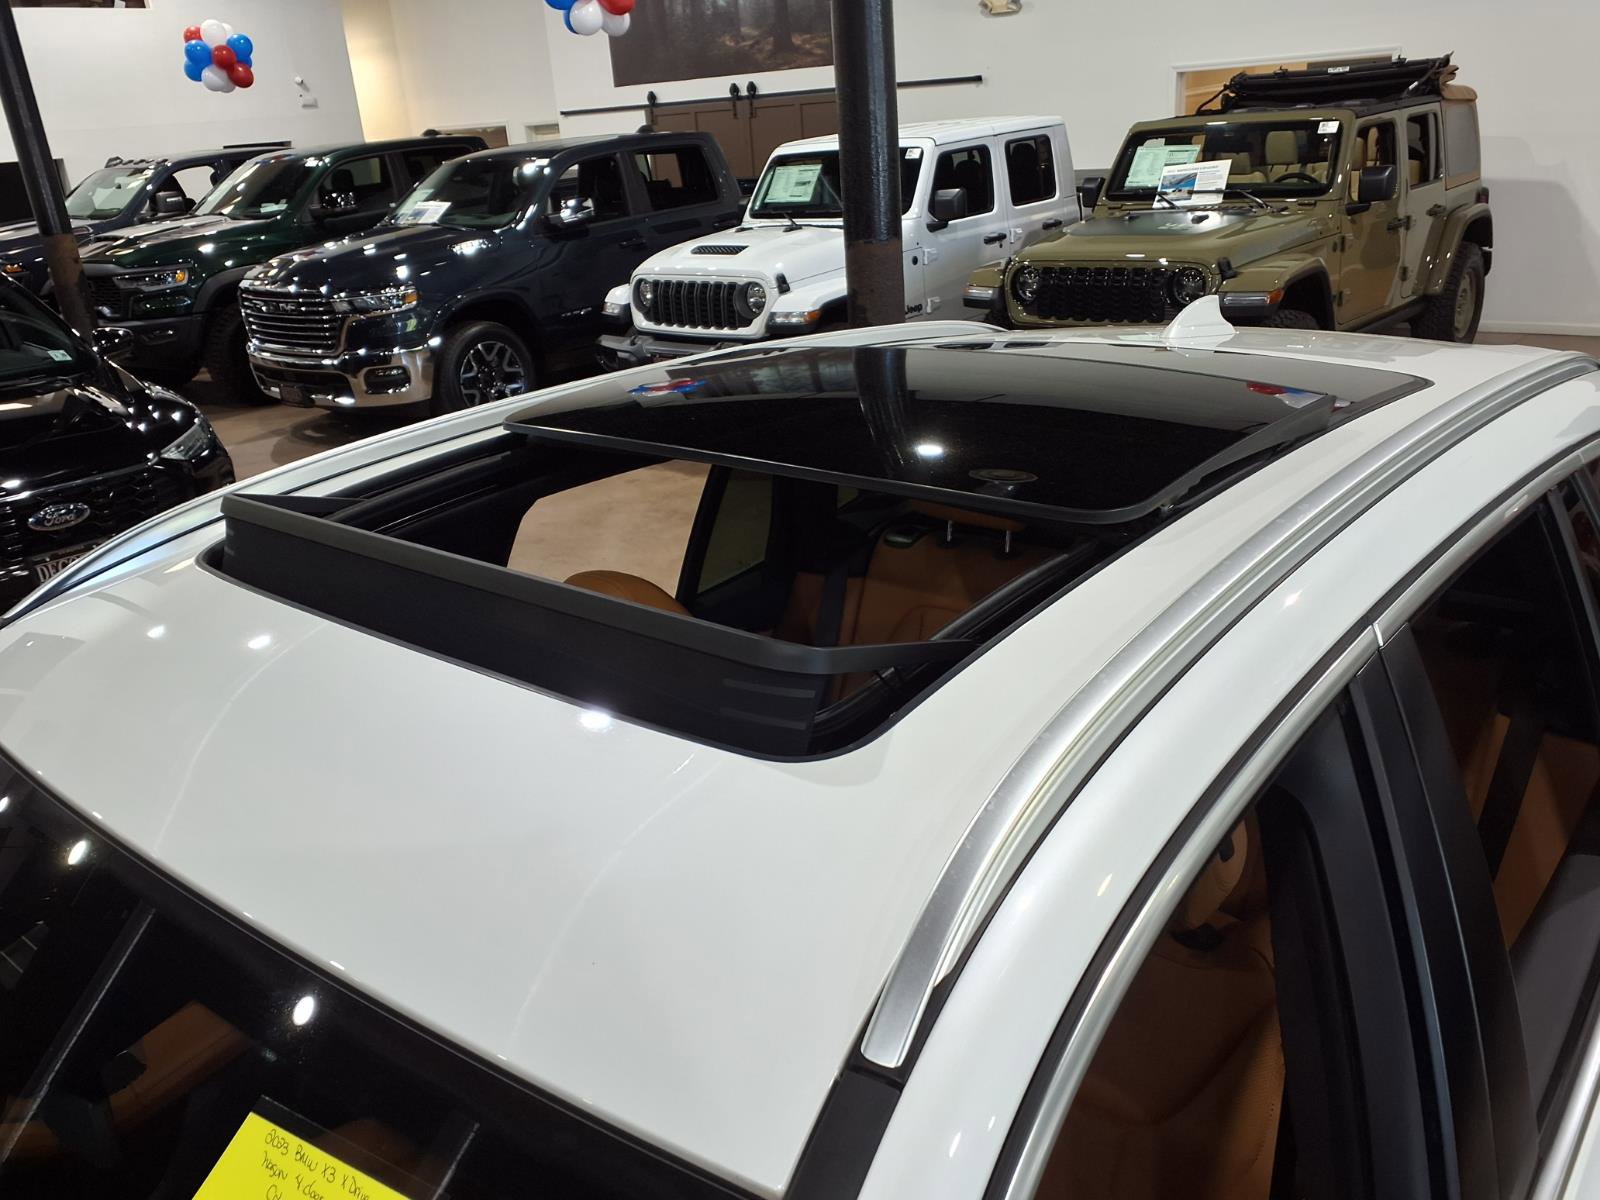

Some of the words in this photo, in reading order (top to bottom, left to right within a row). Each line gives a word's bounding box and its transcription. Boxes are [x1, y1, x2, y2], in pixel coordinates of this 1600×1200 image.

[43, 509, 76, 526] Ford
[264, 1128, 290, 1156] 2023
[294, 1144, 318, 1172] BMW
[321, 1163, 337, 1184] X3
[296, 1173, 305, 1191] 4
